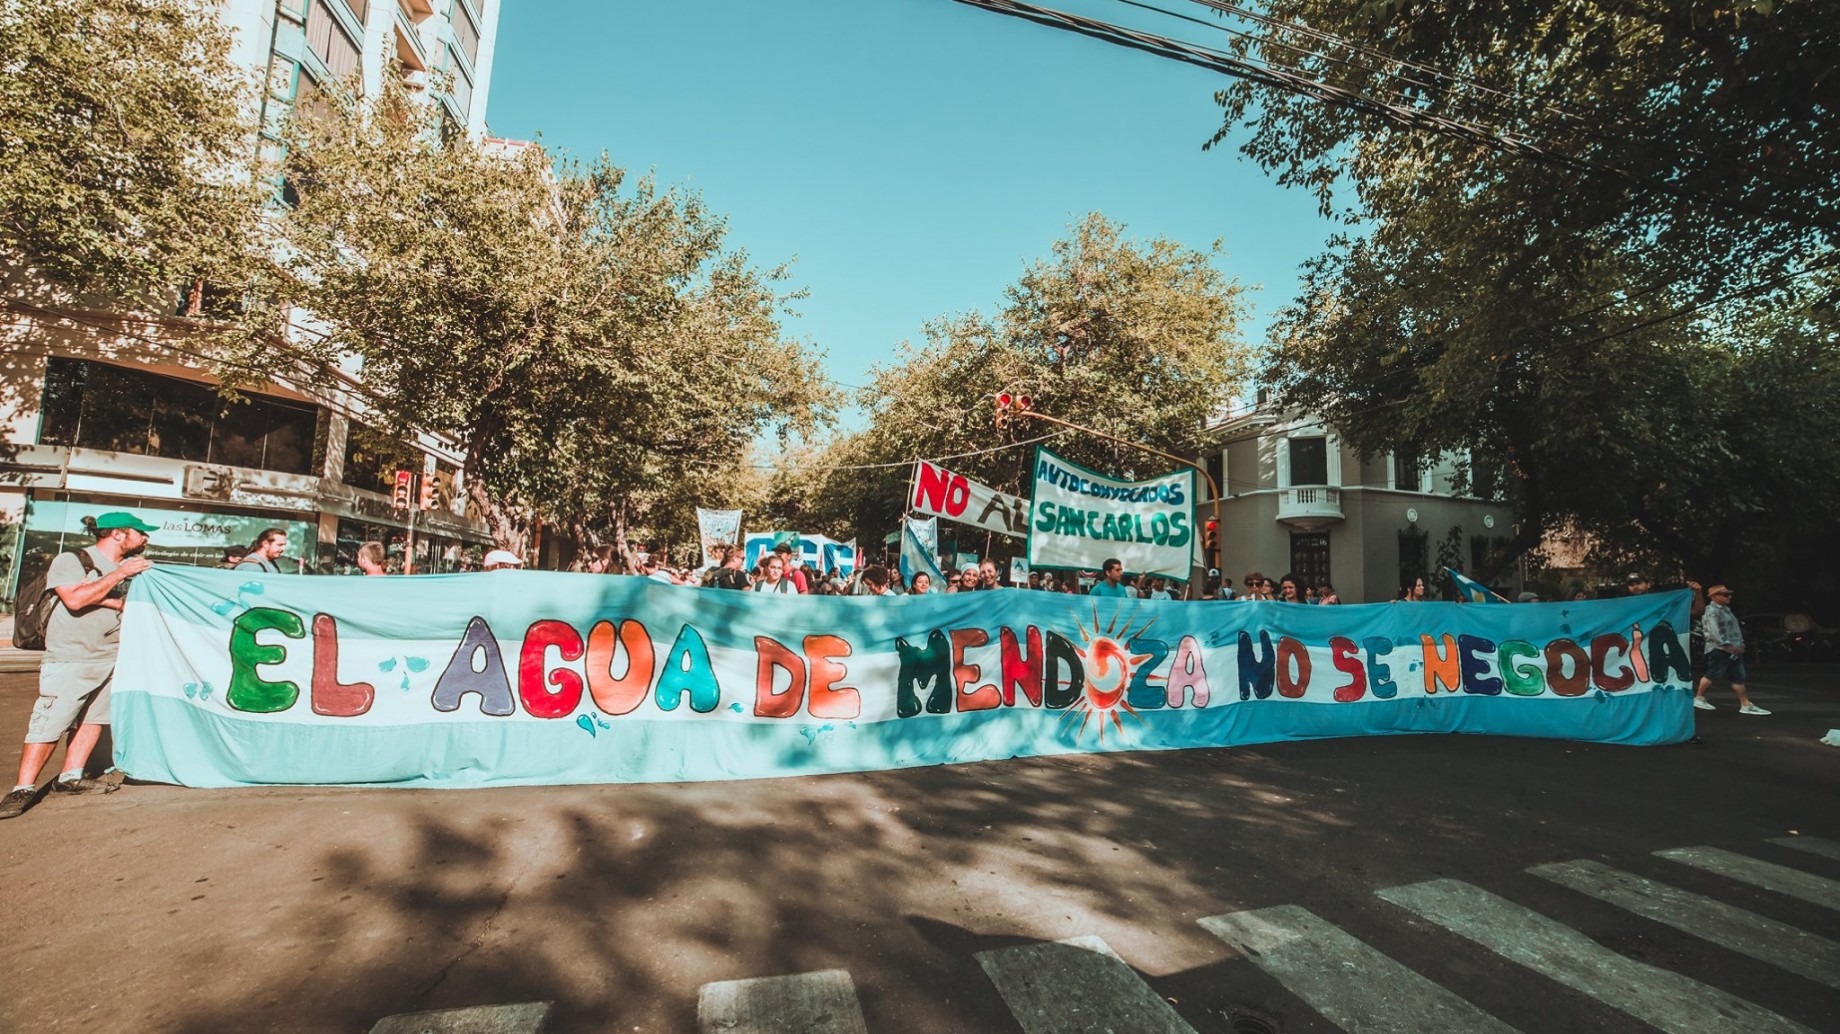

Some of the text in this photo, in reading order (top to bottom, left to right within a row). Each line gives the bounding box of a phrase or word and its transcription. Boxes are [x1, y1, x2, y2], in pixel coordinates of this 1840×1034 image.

[914, 461, 970, 517] NO
[226, 607, 375, 717] EL
[431, 616, 721, 719] AGUA
[753, 634, 861, 719] DE
[895, 624, 1211, 719] MENDOZA
[1237, 630, 1311, 701] NO
[1328, 636, 1398, 702] SE
